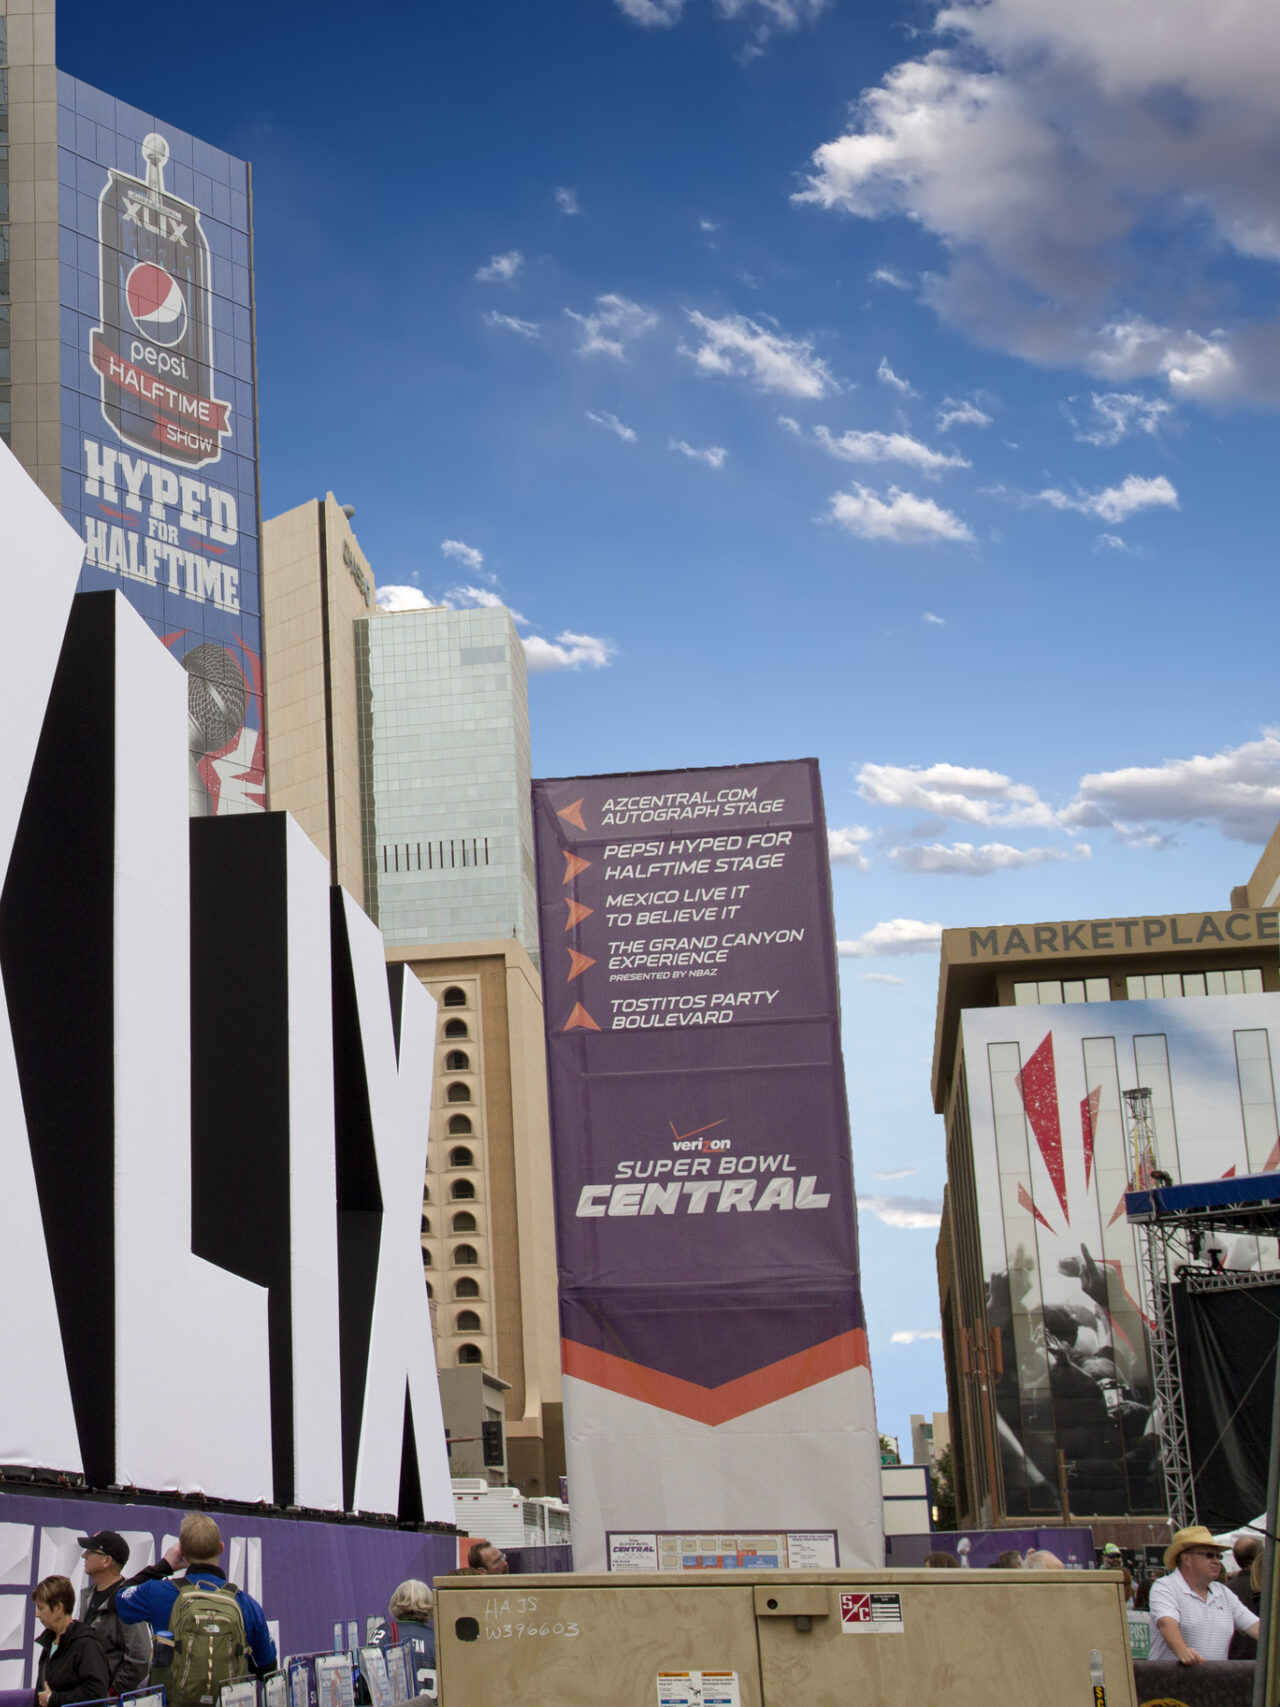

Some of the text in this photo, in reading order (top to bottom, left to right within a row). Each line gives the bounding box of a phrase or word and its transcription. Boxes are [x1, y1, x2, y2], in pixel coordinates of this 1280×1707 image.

[121, 196, 189, 248] XLIX
[130, 340, 187, 380] pepsi
[109, 356, 210, 422] HALFTIME
[166, 423, 213, 453] SHOW
[83, 439, 240, 546] HYPED
[148, 518, 180, 545] FOR
[85, 516, 241, 616] HALFTIME
[601, 787, 758, 812] AZCENTRAL.COM
[601, 799, 785, 826] AUTOGRAPH STAGE
[604, 831, 793, 860] PEPSI HYPED FOR
[605, 853, 785, 881] HALFTIME STAGE
[606, 885, 750, 908] MEXICO LIVE IT
[606, 905, 741, 927] TO BELIEVE IT
[608, 928, 805, 955] THE GRAND CANYON
[970, 910, 1280, 958] MARKETPLACE
[608, 950, 729, 970] EXPERIENCE
[609, 968, 718, 982] PRESENTED BY NBAZ
[611, 990, 780, 1013] TOSTITOS PARTY
[612, 1010, 734, 1030] BOULEVARD
[672, 1137, 731, 1154] verizon
[614, 1154, 798, 1180] SUPER BOWL
[575, 1175, 832, 1218] CENTRAL
